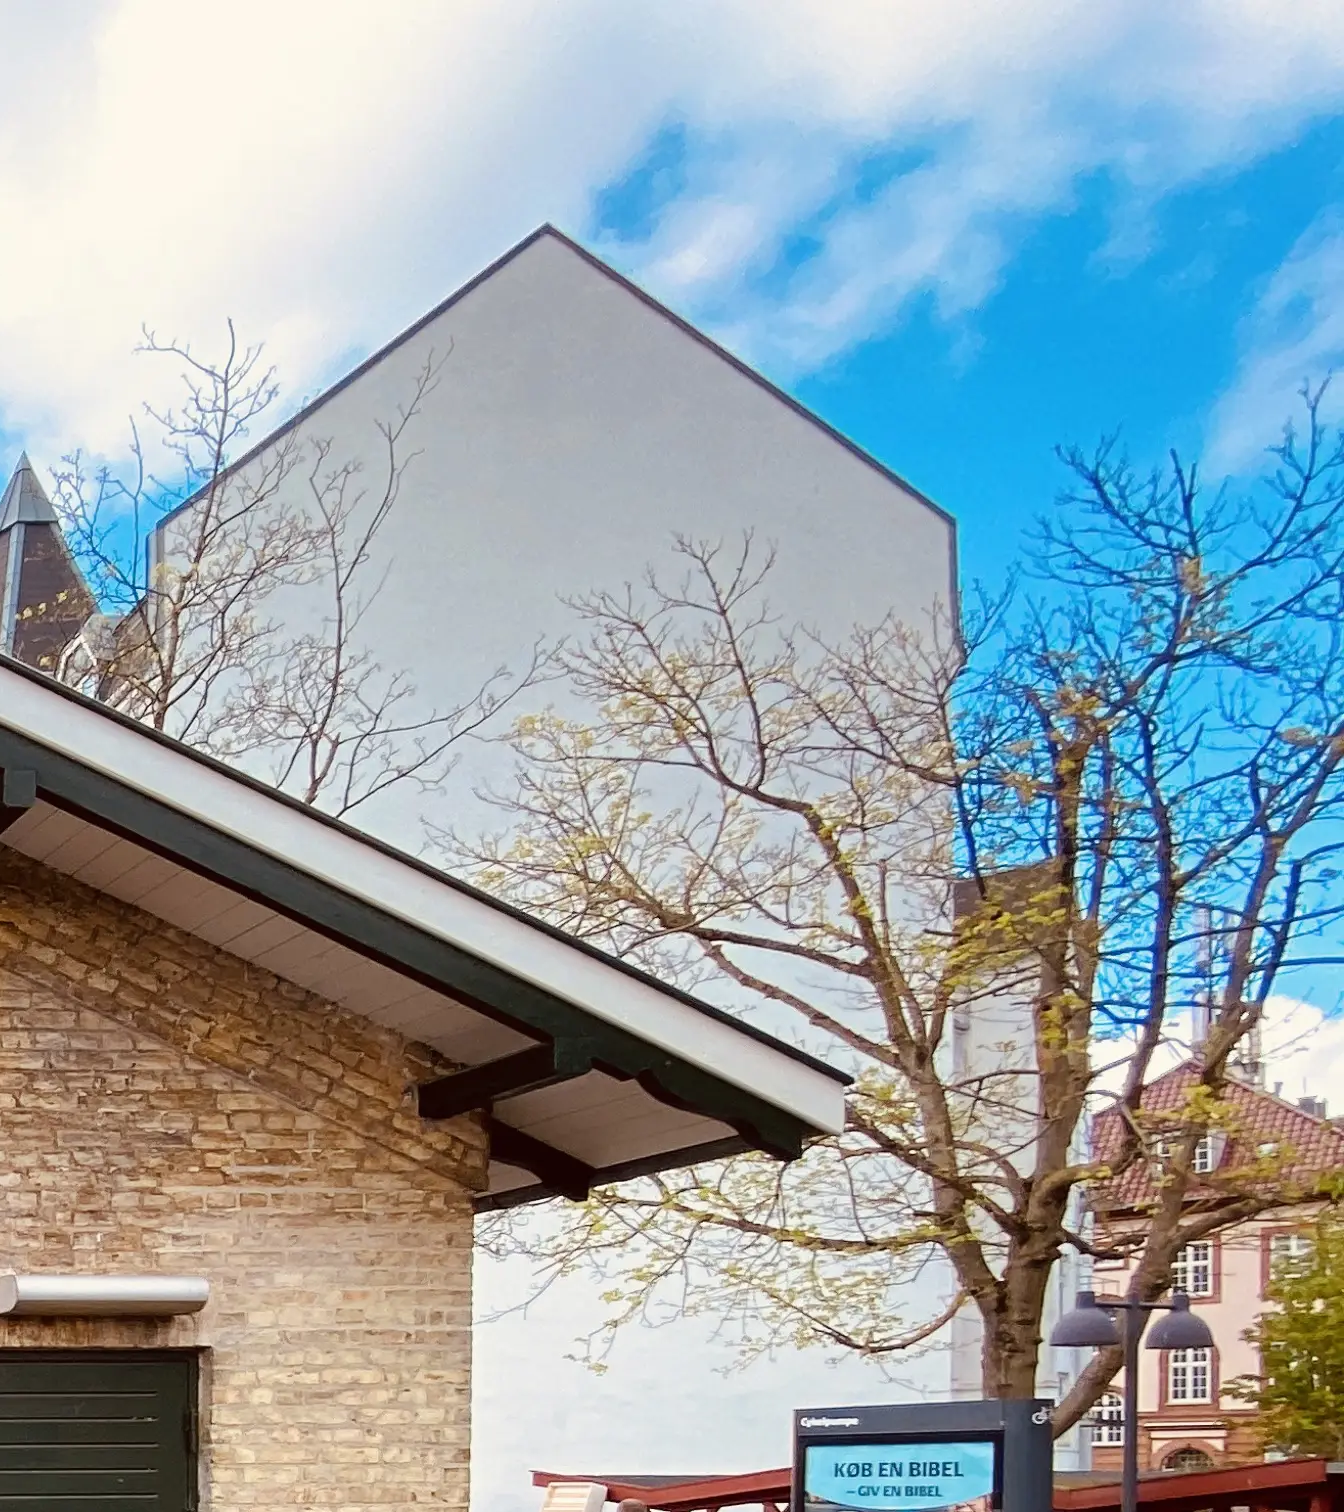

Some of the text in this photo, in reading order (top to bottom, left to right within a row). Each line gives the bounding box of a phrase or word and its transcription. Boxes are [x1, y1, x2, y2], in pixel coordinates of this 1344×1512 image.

[833, 1461, 965, 1478] KØB EN BIBEL
[883, 1485, 901, 1497] EN
[904, 1485, 944, 1498] BIBEL
